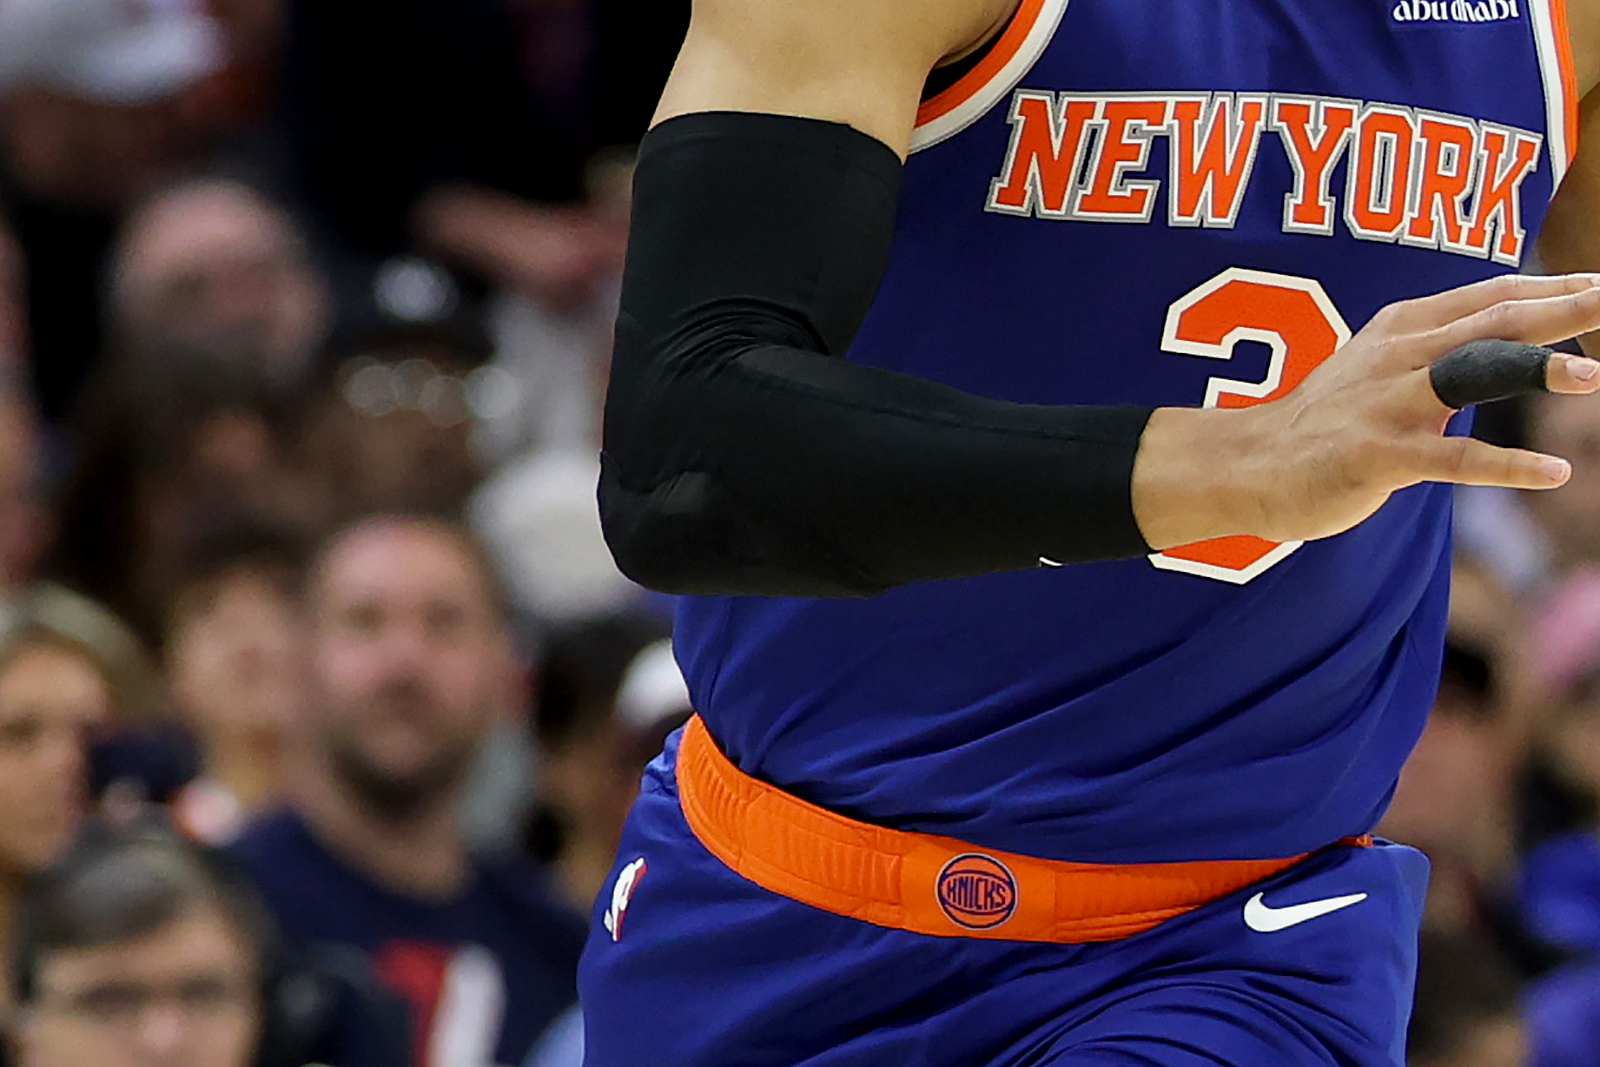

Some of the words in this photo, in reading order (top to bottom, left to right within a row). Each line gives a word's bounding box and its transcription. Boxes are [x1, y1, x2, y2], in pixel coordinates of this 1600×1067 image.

[984, 88, 1271, 229] NEW
[1268, 91, 1543, 267] YORK
[1148, 266, 1352, 585] 3
[946, 875, 1007, 910] KNICKS
